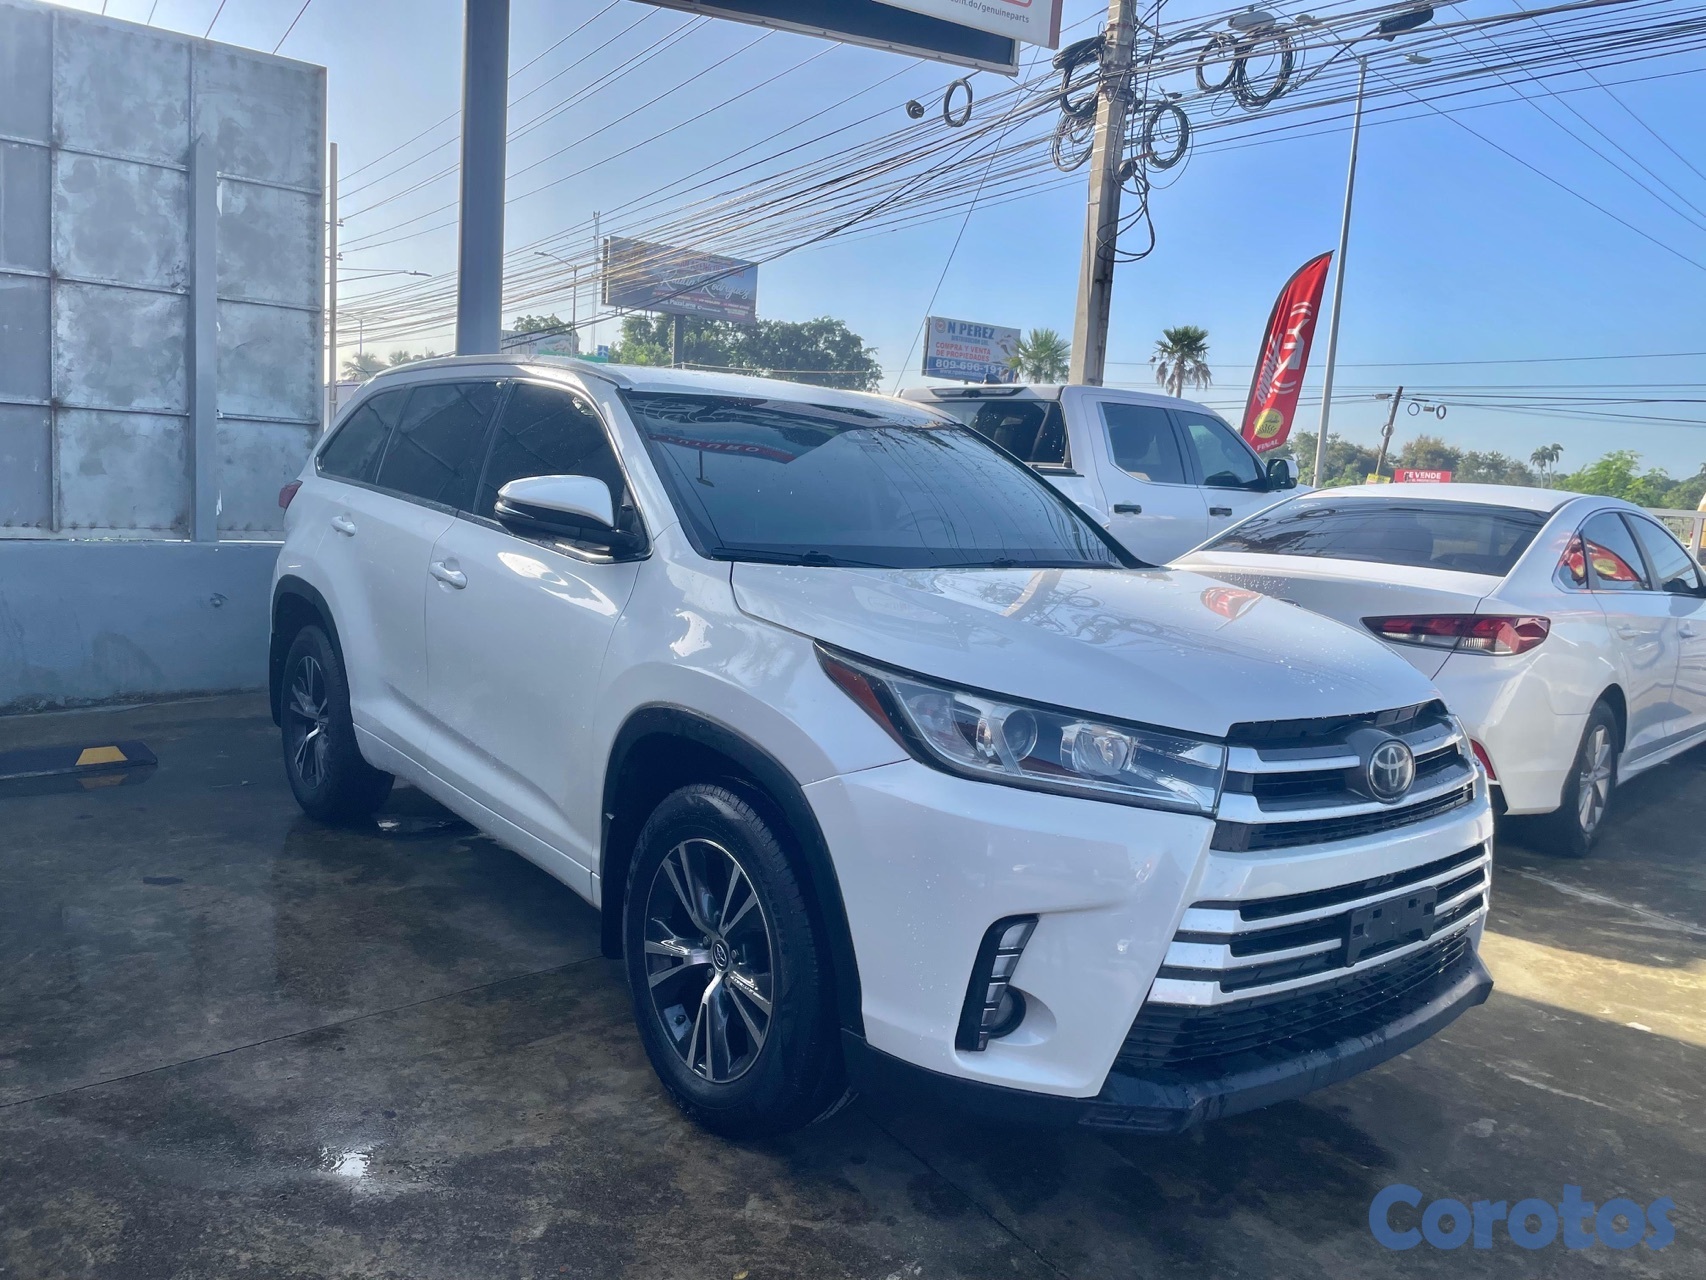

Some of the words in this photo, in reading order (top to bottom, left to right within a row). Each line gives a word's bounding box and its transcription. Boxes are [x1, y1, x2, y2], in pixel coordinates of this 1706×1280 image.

[947, 321, 956, 334] N
[959, 322, 995, 339] PEREZ
[936, 341, 962, 351] COMPRA
[971, 346, 991, 355] VENTA
[936, 349, 946, 357] DE
[946, 350, 990, 362] PROPIEDADES
[1256, 439, 1279, 451] FINAL
[1415, 471, 1441, 479] VENDE
